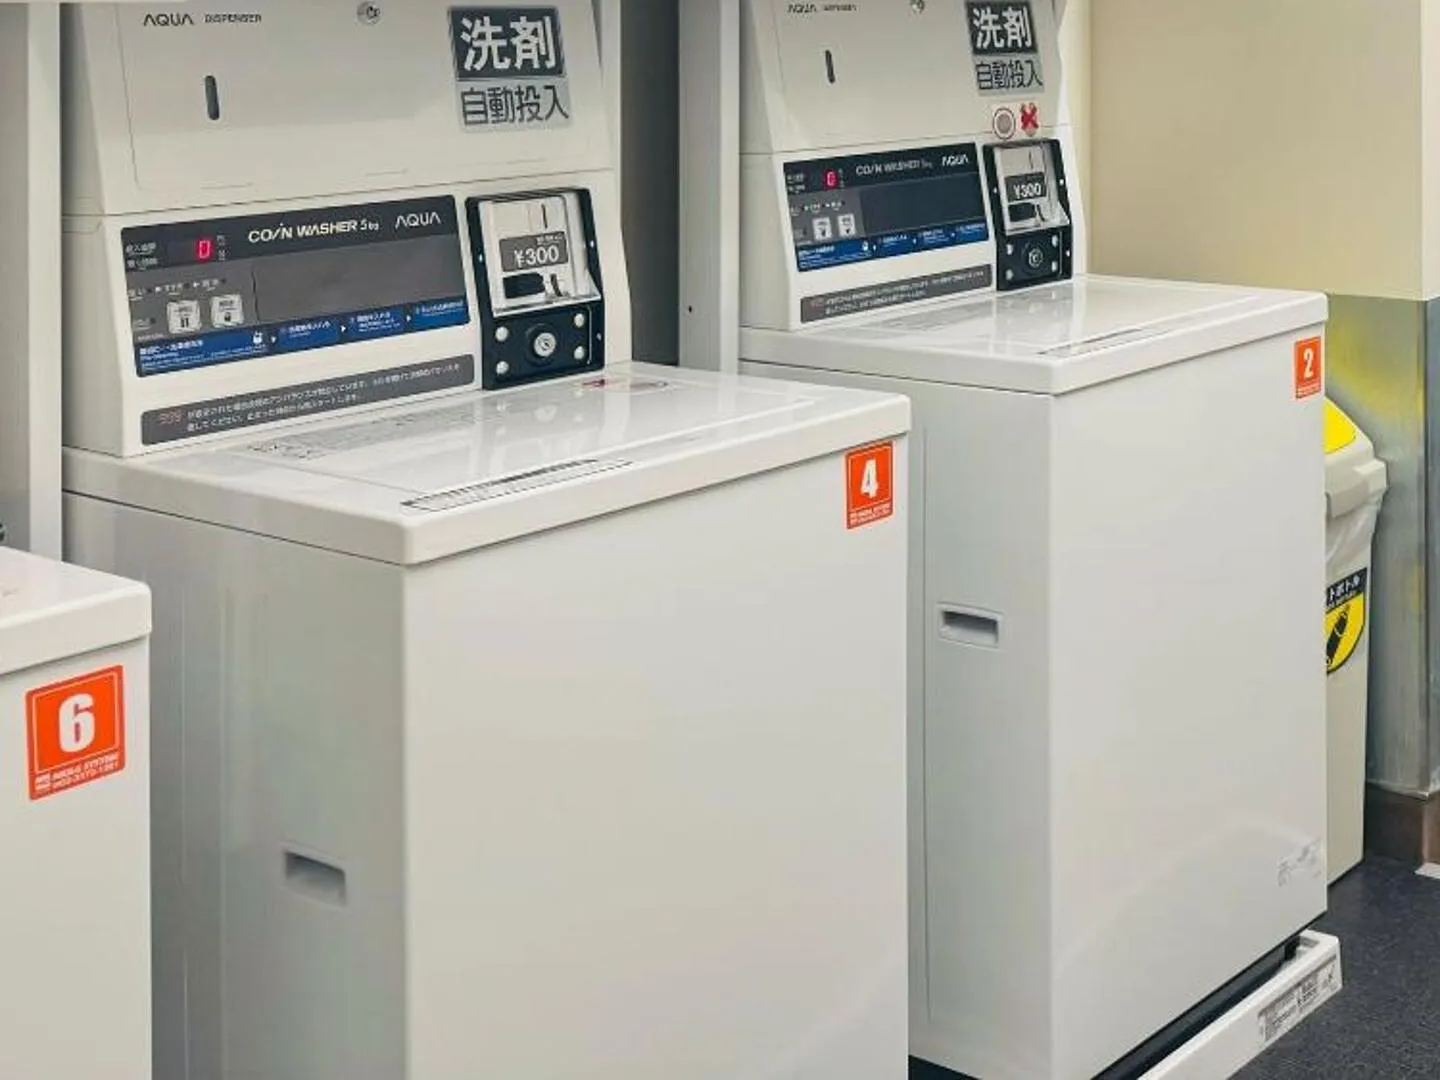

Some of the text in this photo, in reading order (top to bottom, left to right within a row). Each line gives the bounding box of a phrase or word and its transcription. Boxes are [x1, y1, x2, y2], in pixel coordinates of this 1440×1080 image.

[143, 13, 194, 27] AQUA
[972, 6, 1032, 49] 洗剤
[460, 16, 557, 72] 洗剤
[975, 59, 1043, 91] 自動投入
[460, 84, 570, 126] 自動投入
[1013, 182, 1042, 200] ¥300
[248, 222, 293, 244] COIN
[297, 219, 357, 238] WASHER
[395, 210, 441, 230] AQUA
[514, 244, 560, 268] ¥300
[1303, 348, 1314, 379] 2
[861, 459, 880, 499] 4
[1329, 574, 1361, 602] トボトル
[59, 693, 96, 753] 6
